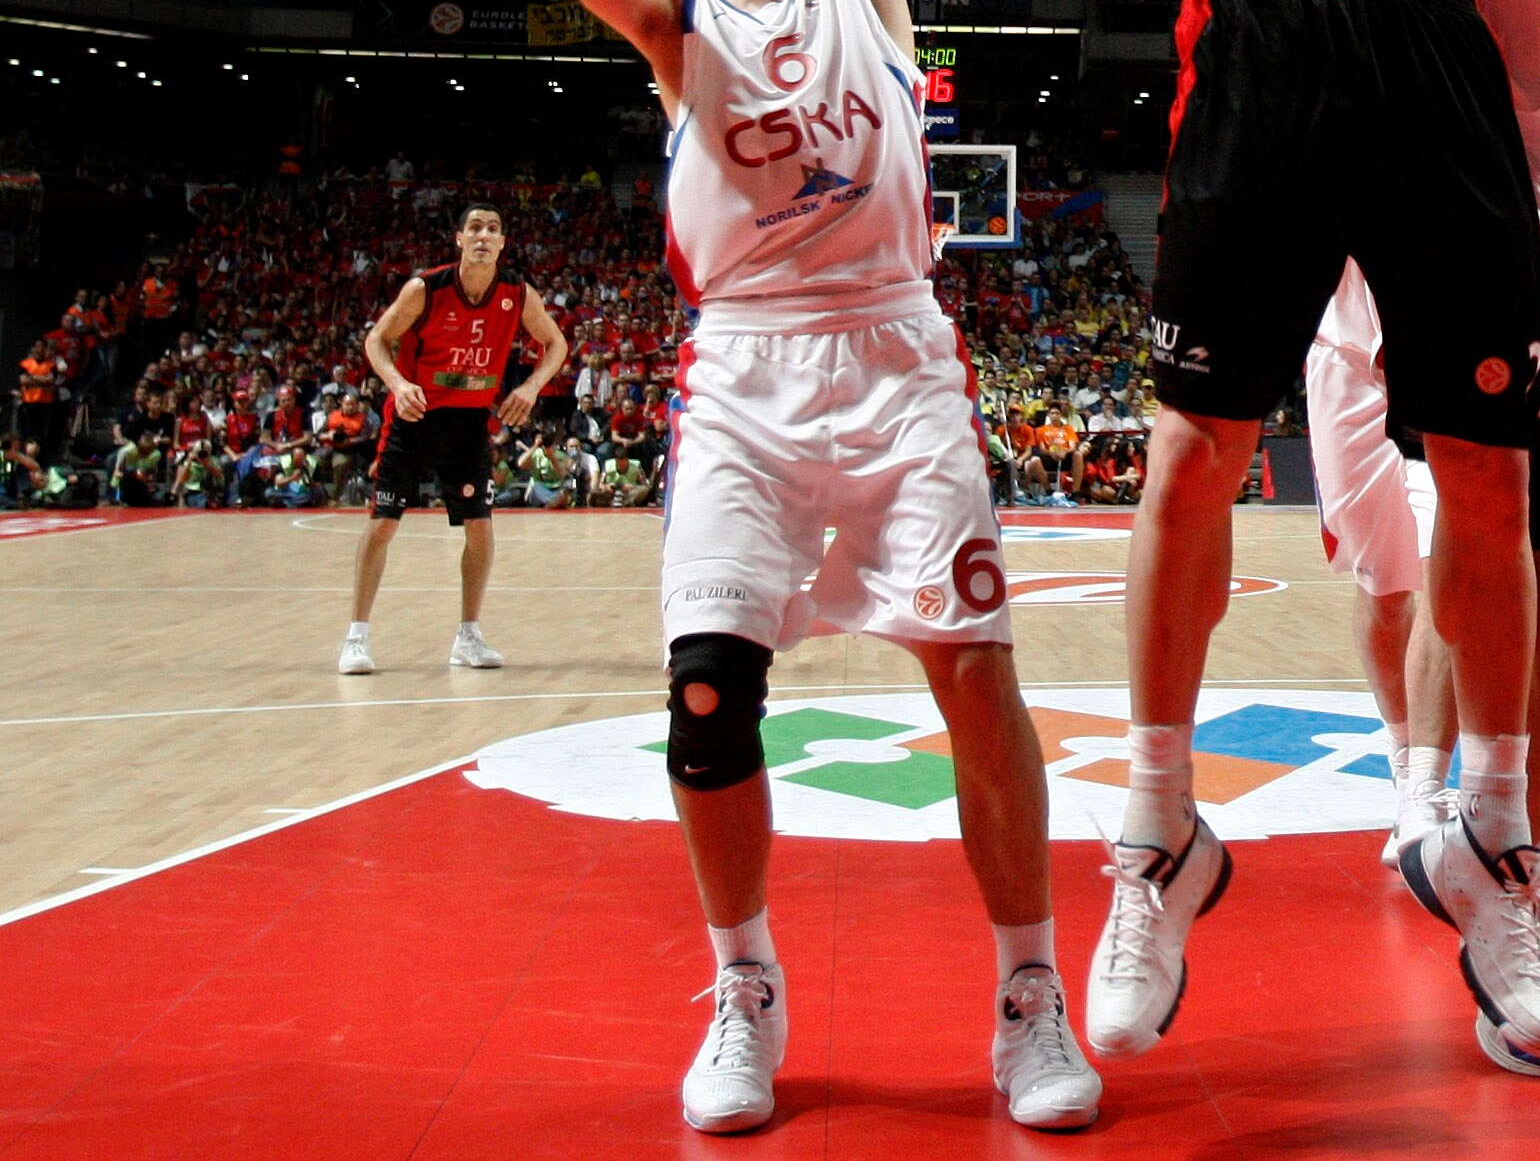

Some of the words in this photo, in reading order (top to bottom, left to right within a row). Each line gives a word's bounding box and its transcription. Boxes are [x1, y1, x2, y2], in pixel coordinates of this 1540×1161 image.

[468, 21, 530, 31] BASKET
[471, 10, 529, 21] EUROLE
[762, 32, 819, 94] 6
[724, 90, 882, 168] CSKA
[755, 200, 821, 230] NORILSK
[470, 319, 485, 345] 5
[448, 346, 494, 368] TAU
[484, 478, 496, 506] 5
[952, 538, 1007, 613] 6
[685, 585, 706, 602] PAL
[707, 586, 747, 601] ZILERI
